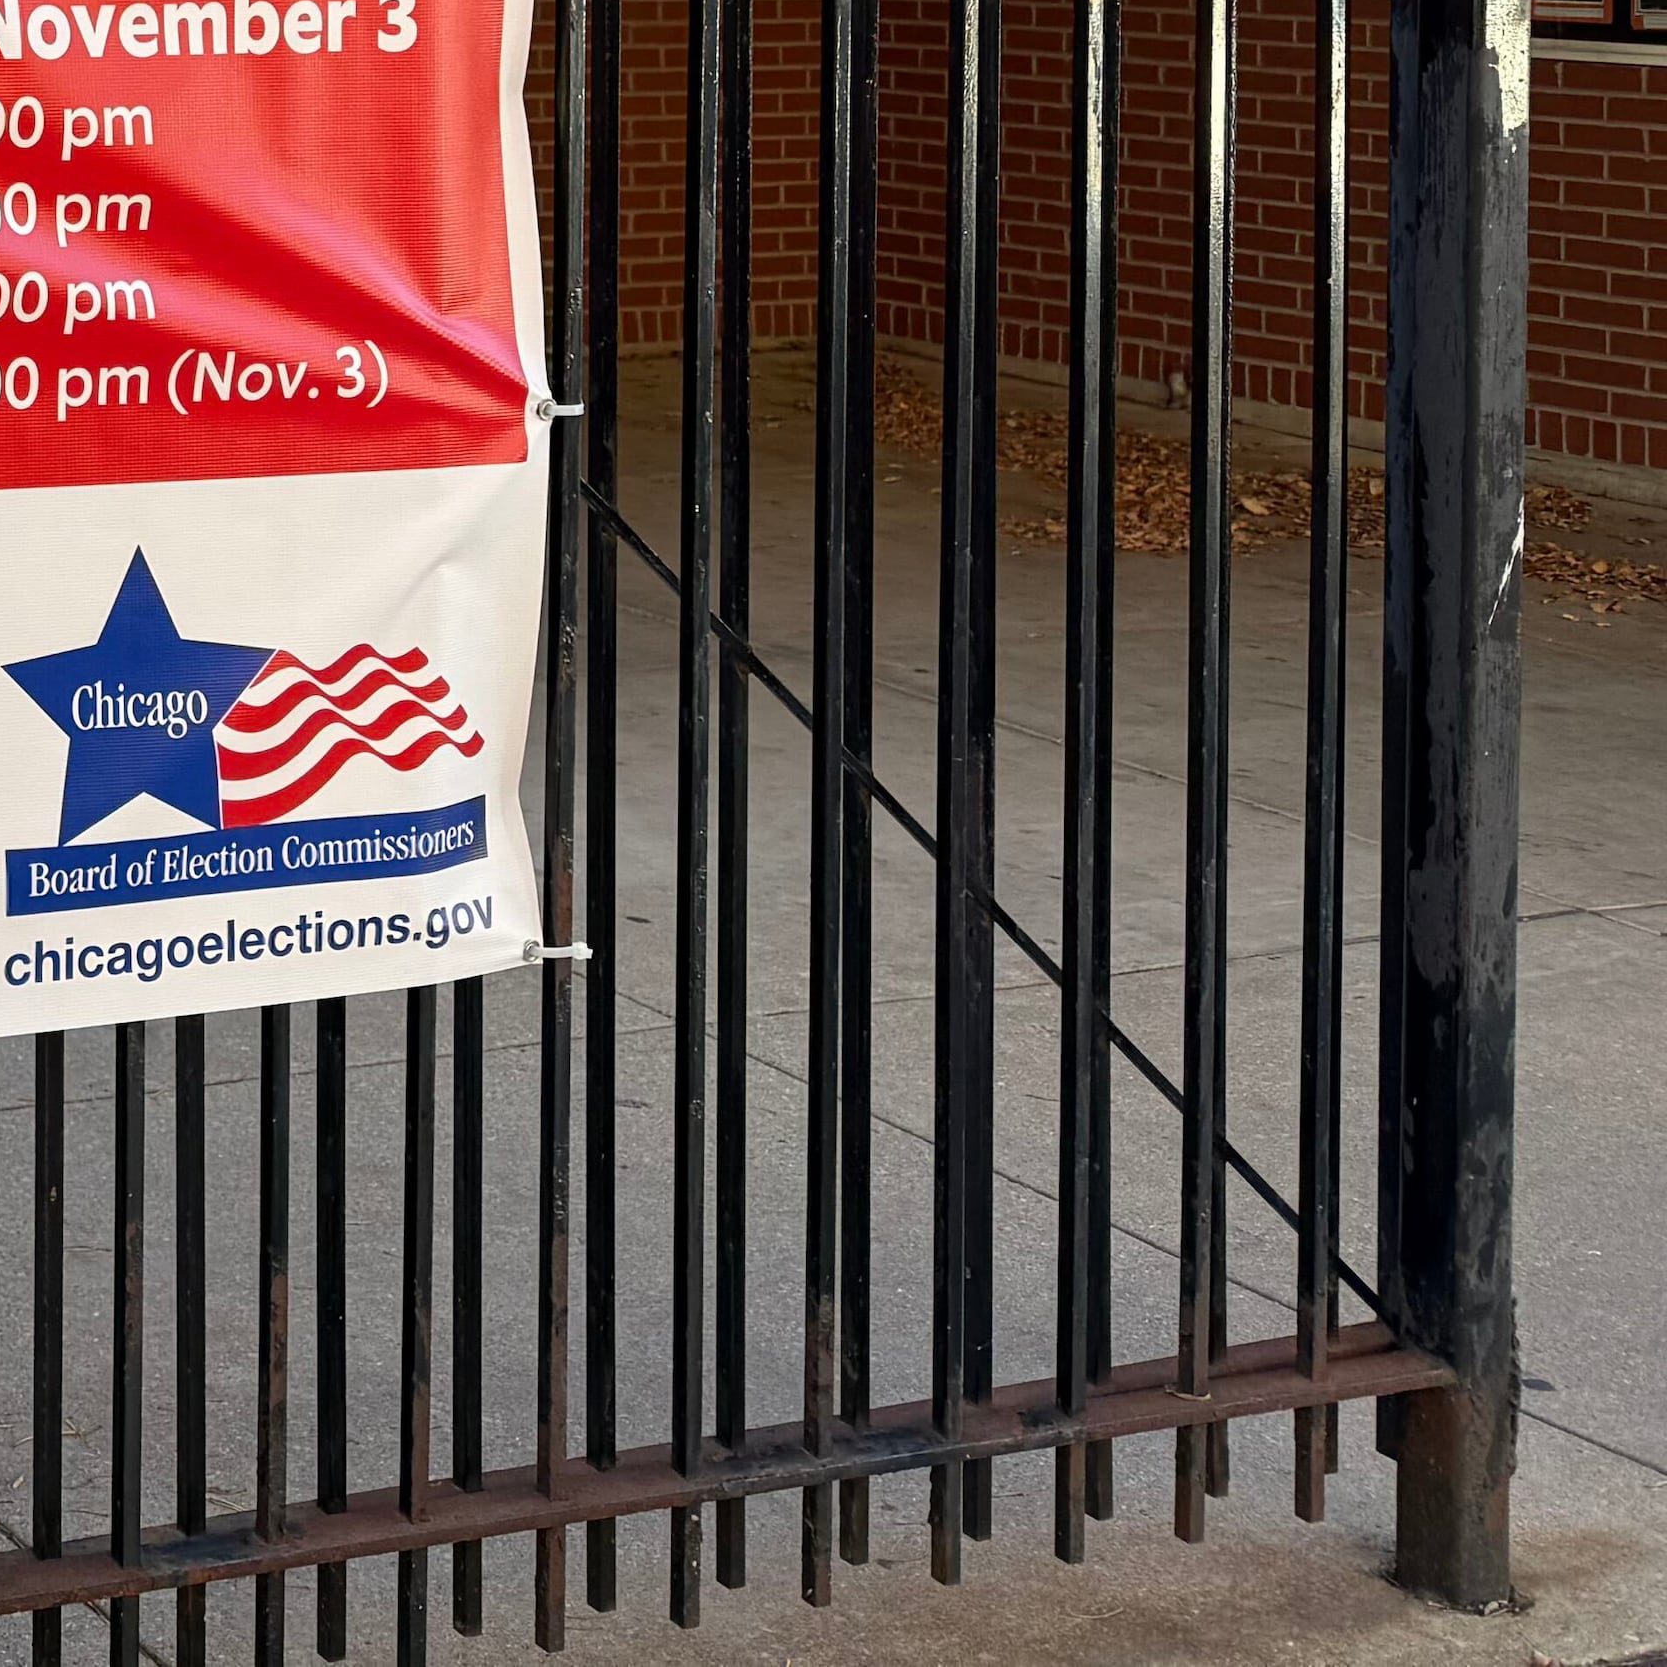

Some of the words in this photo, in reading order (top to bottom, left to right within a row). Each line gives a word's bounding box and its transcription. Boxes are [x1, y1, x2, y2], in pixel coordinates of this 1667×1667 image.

[63, 106, 153, 160] pm
[57, 195, 150, 247] pm
[65, 280, 155, 334] pm
[58, 367, 148, 421] pm
[169, 350, 318, 414] (Nov.
[337, 341, 388, 407] 3)
[71, 680, 208, 738] Chicago
[28, 855, 117, 897] Board
[127, 848, 156, 886] of
[162, 838, 273, 884] Election
[281, 816, 475, 870] Commissioners
[3, 896, 493, 987] chicagoelections.gov
